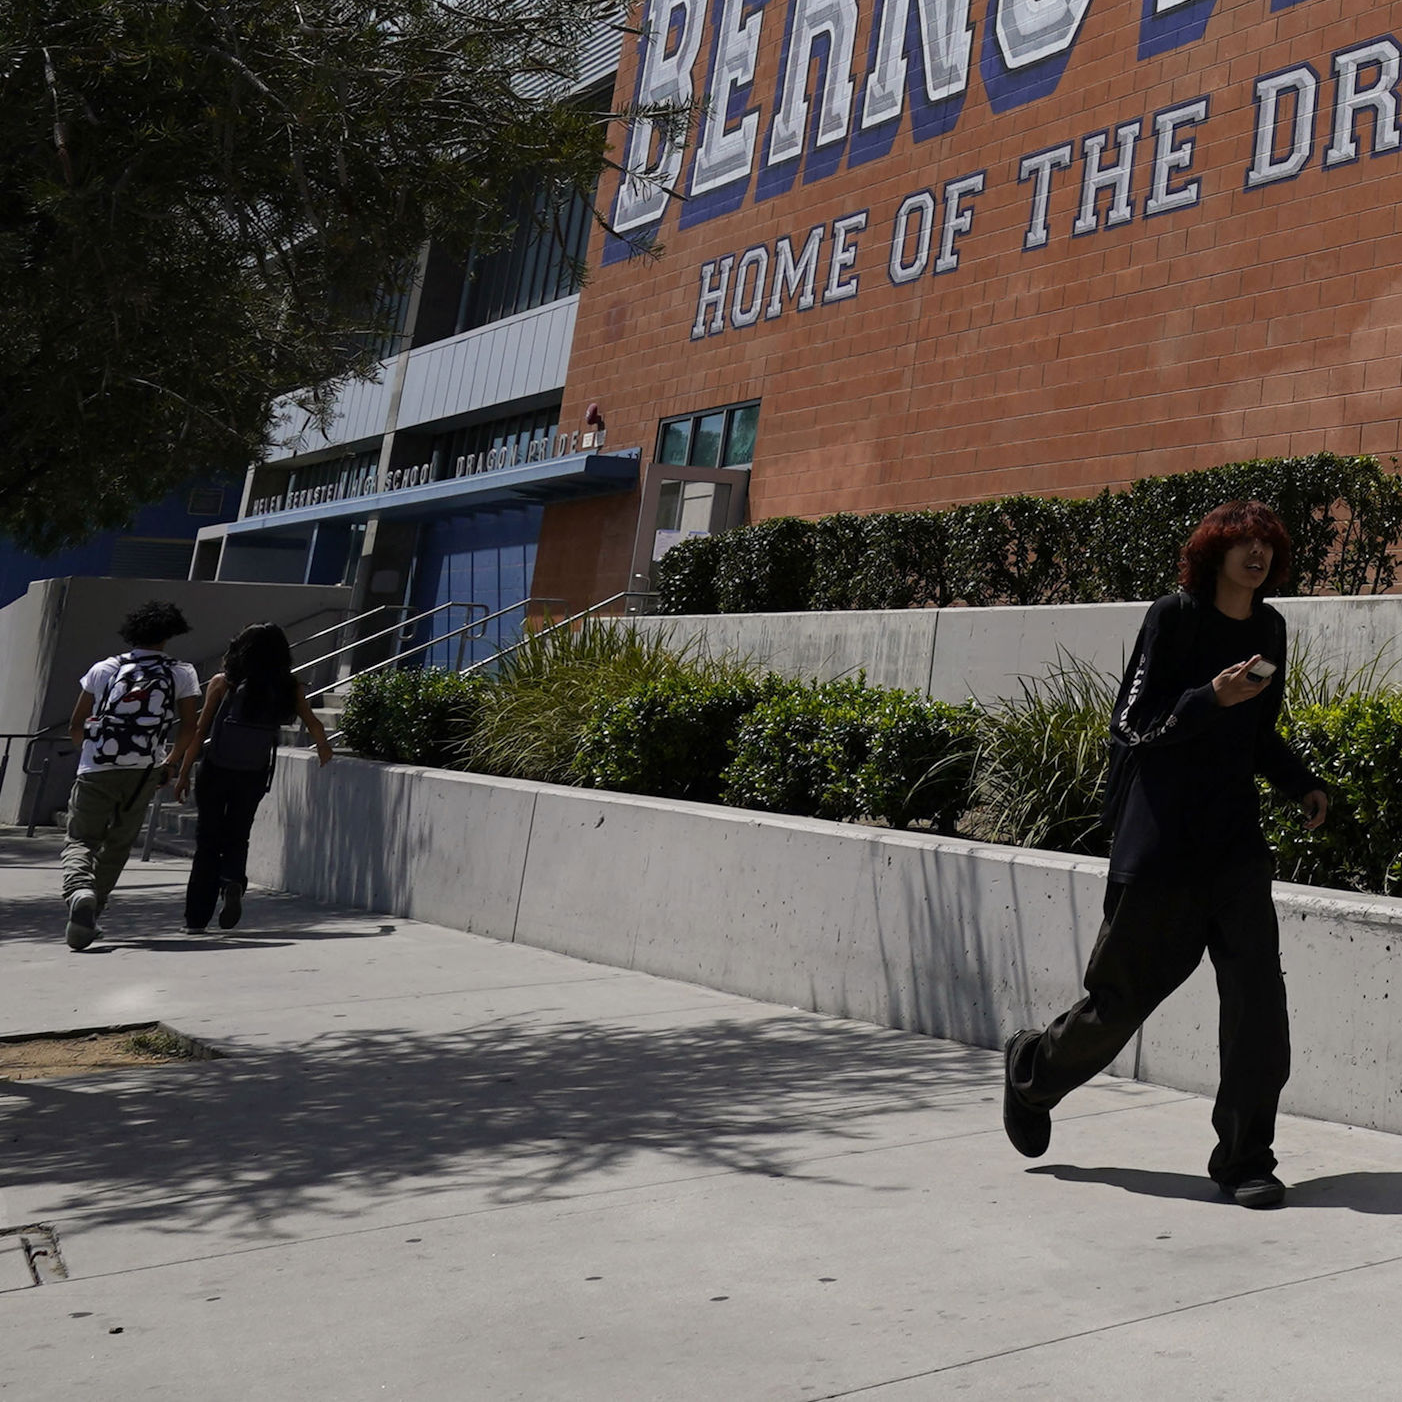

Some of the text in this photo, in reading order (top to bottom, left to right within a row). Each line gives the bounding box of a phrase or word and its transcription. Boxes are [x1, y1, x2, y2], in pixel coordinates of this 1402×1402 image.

[689, 209, 868, 341] HOME
[889, 170, 986, 286] OF
[1018, 96, 1211, 252] THE
[252, 494, 282, 517] HELEN
[285, 479, 347, 510] BERNSTEIN
[350, 474, 378, 499] HIGH
[384, 462, 434, 493] SCHOOL
[456, 444, 519, 478] DRAGON
[527, 430, 580, 464] PRIDE
